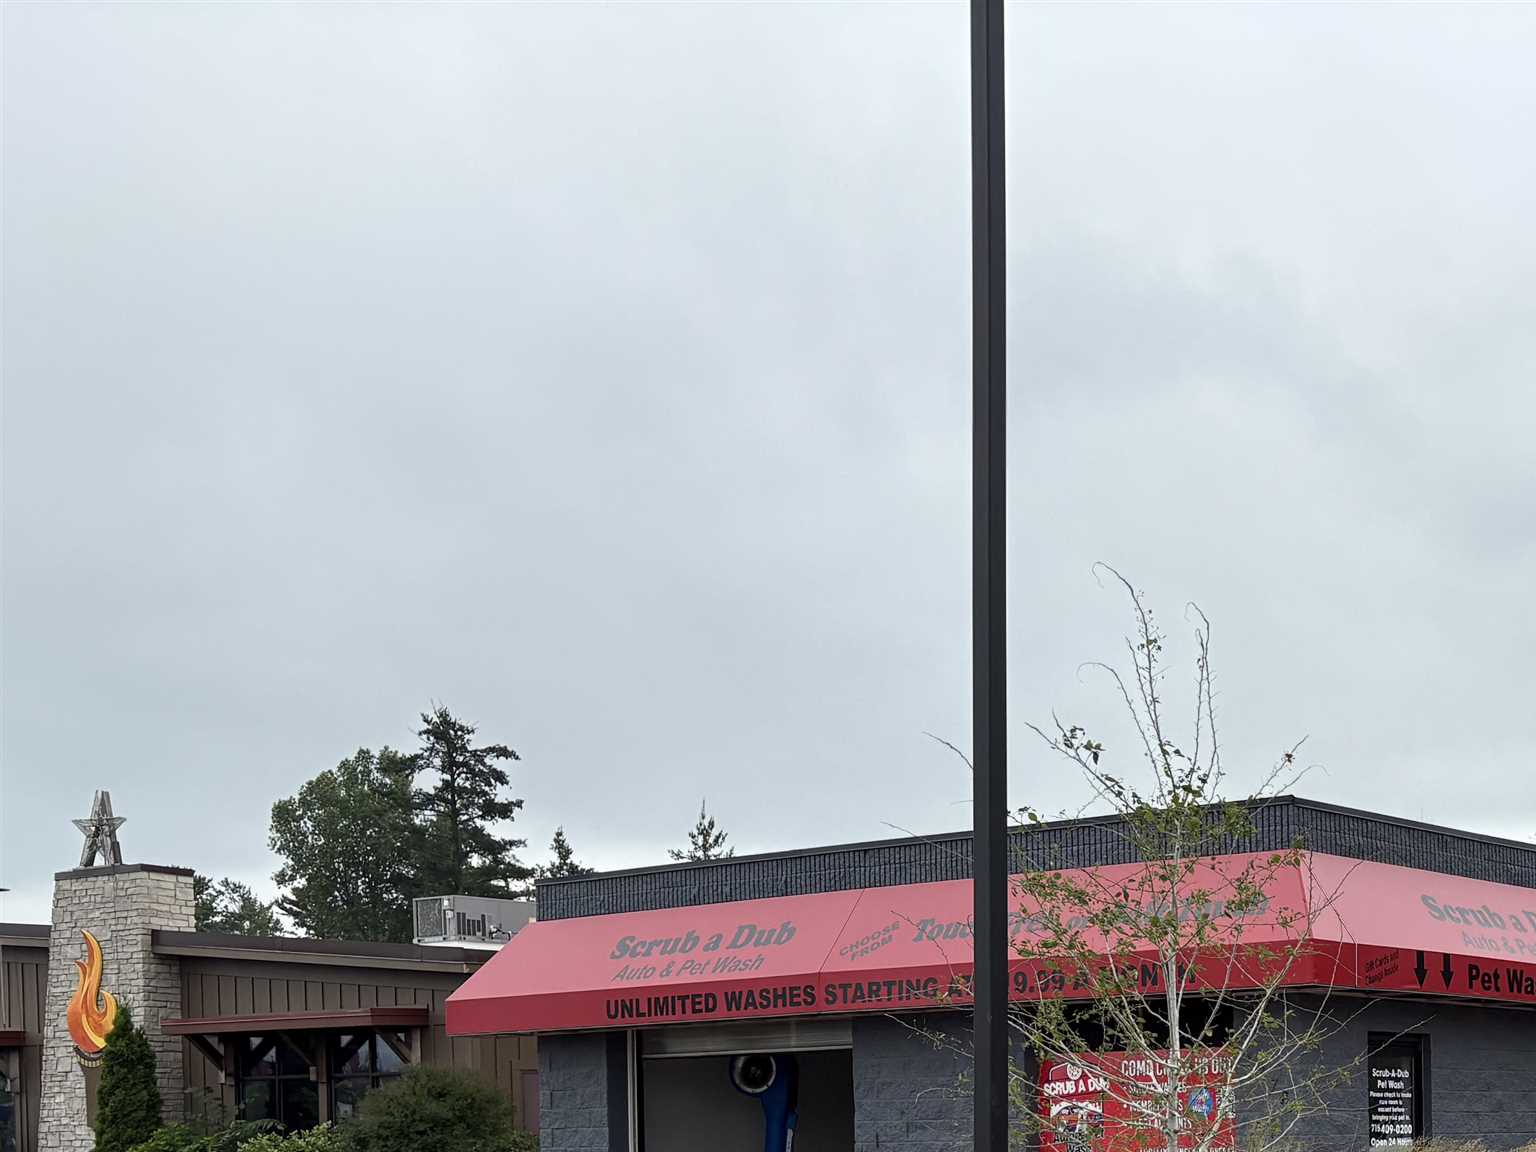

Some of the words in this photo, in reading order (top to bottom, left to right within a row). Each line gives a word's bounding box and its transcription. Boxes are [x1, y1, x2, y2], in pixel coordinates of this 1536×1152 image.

[1421, 894, 1506, 930] Scrub
[1510, 914, 1528, 934] a
[609, 929, 700, 960] Scrub
[702, 932, 724, 953] a
[726, 920, 797, 950] Dub
[839, 920, 901, 957] CHOOSE
[849, 934, 894, 961] FROM
[1462, 930, 1497, 953] Auto
[1503, 937, 1516, 956] &
[612, 963, 656, 983] Auto
[660, 961, 676, 979] &
[676, 958, 710, 977] Pet
[711, 954, 766, 974] Wash
[1468, 963, 1500, 993] Pet
[606, 991, 719, 1020] UNLIMITED
[724, 984, 817, 1012] WASHES
[824, 976, 939, 1007] STARTING
[1372, 1068, 1409, 1078] Scrub-A-Dub
[1377, 1080, 1387, 1089] Pet
[1388, 1080, 1404, 1089] Wash
[1043, 1079, 1076, 1097] SCRUB
[1078, 1080, 1086, 1093] A
[1370, 1137, 1388, 1149] Open
[1388, 1137, 1396, 1146] 24
